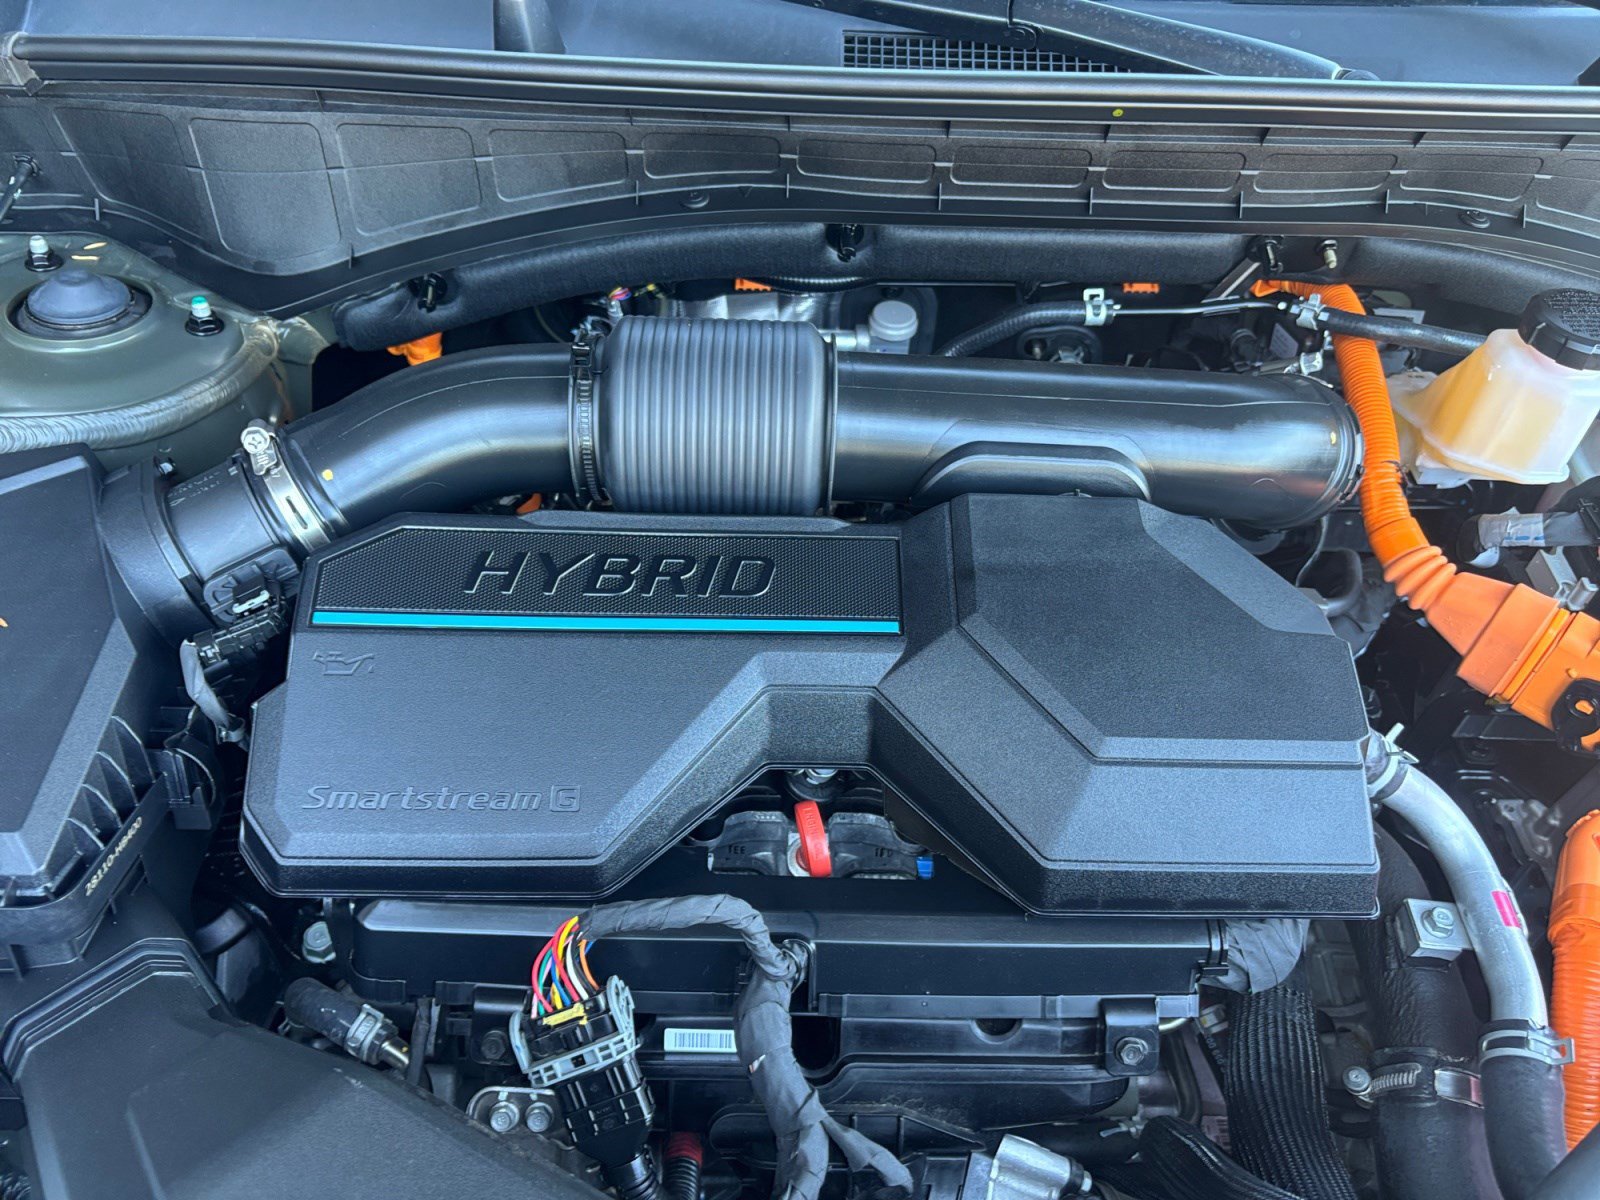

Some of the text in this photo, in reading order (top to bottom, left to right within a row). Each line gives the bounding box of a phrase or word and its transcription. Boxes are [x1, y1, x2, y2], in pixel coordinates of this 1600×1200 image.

[463, 550, 777, 598] HYBRID
[301, 785, 579, 811] Smartstream G
